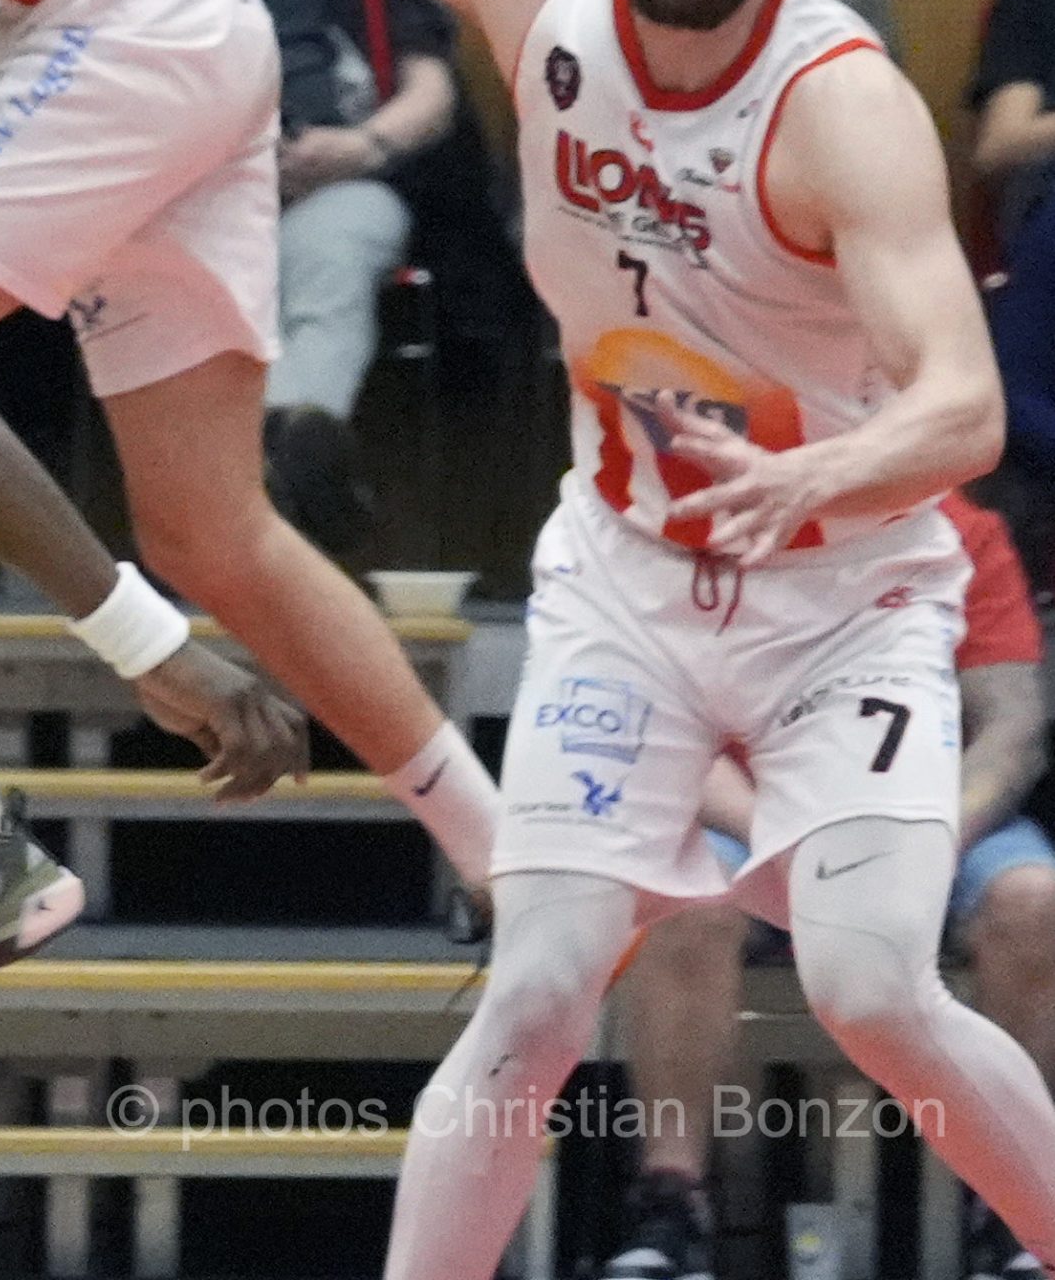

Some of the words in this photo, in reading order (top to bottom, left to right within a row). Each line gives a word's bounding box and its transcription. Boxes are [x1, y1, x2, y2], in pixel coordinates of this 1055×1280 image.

[555, 128, 713, 251] LIONS
[618, 249, 649, 317] 7
[536, 703, 622, 733] EXCO
[858, 697, 911, 773] 7
